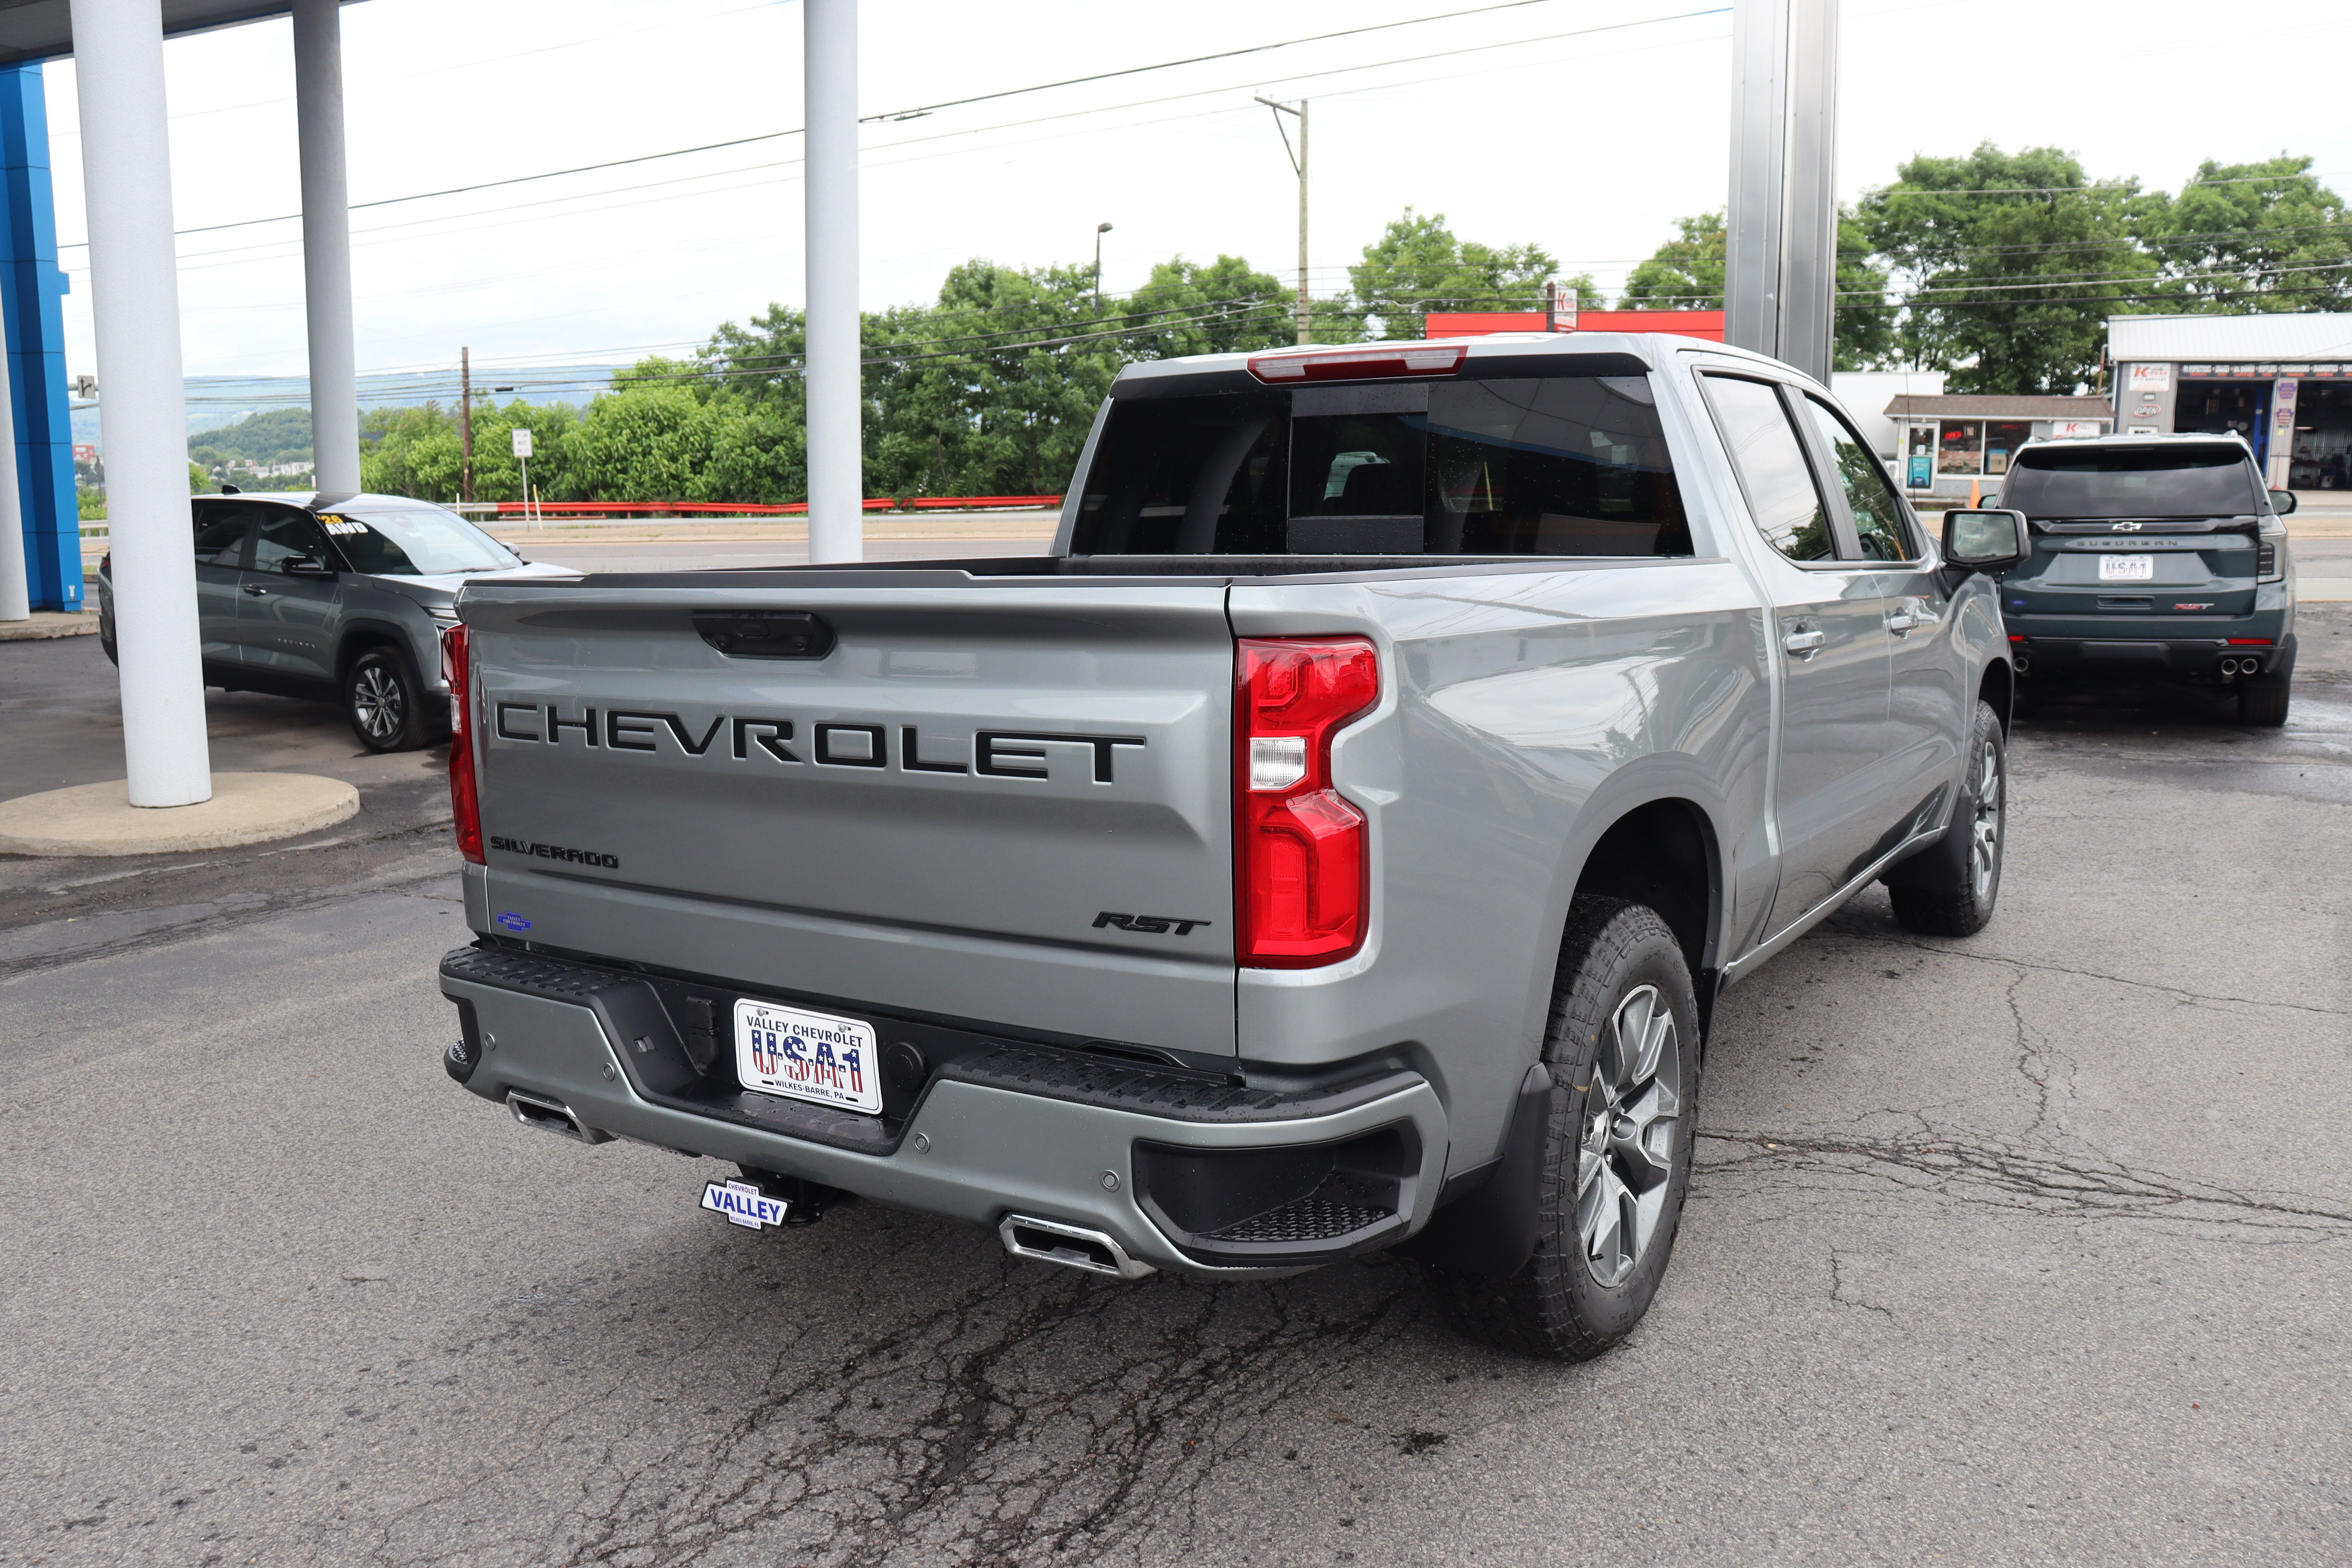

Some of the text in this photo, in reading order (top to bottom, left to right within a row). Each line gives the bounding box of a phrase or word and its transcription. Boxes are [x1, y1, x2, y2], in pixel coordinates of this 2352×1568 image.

[1944, 431, 1962, 440] OPEN
[317, 514, 344, 525] '26
[325, 522, 368, 535] AWD
[496, 702, 1147, 783] CHEVROLET
[490, 835, 619, 869] SILVERADO
[503, 918, 526, 927] CHEVROLET
[1091, 911, 1212, 935] RST
[746, 1015, 862, 1048] VALLEY CHEVROLET
[775, 1079, 844, 1100] WILKES-BARRE, PA
[728, 1183, 757, 1196] CHEVROLET
[710, 1188, 780, 1223] VALLEY
[742, 1218, 754, 1227] BARRE,
